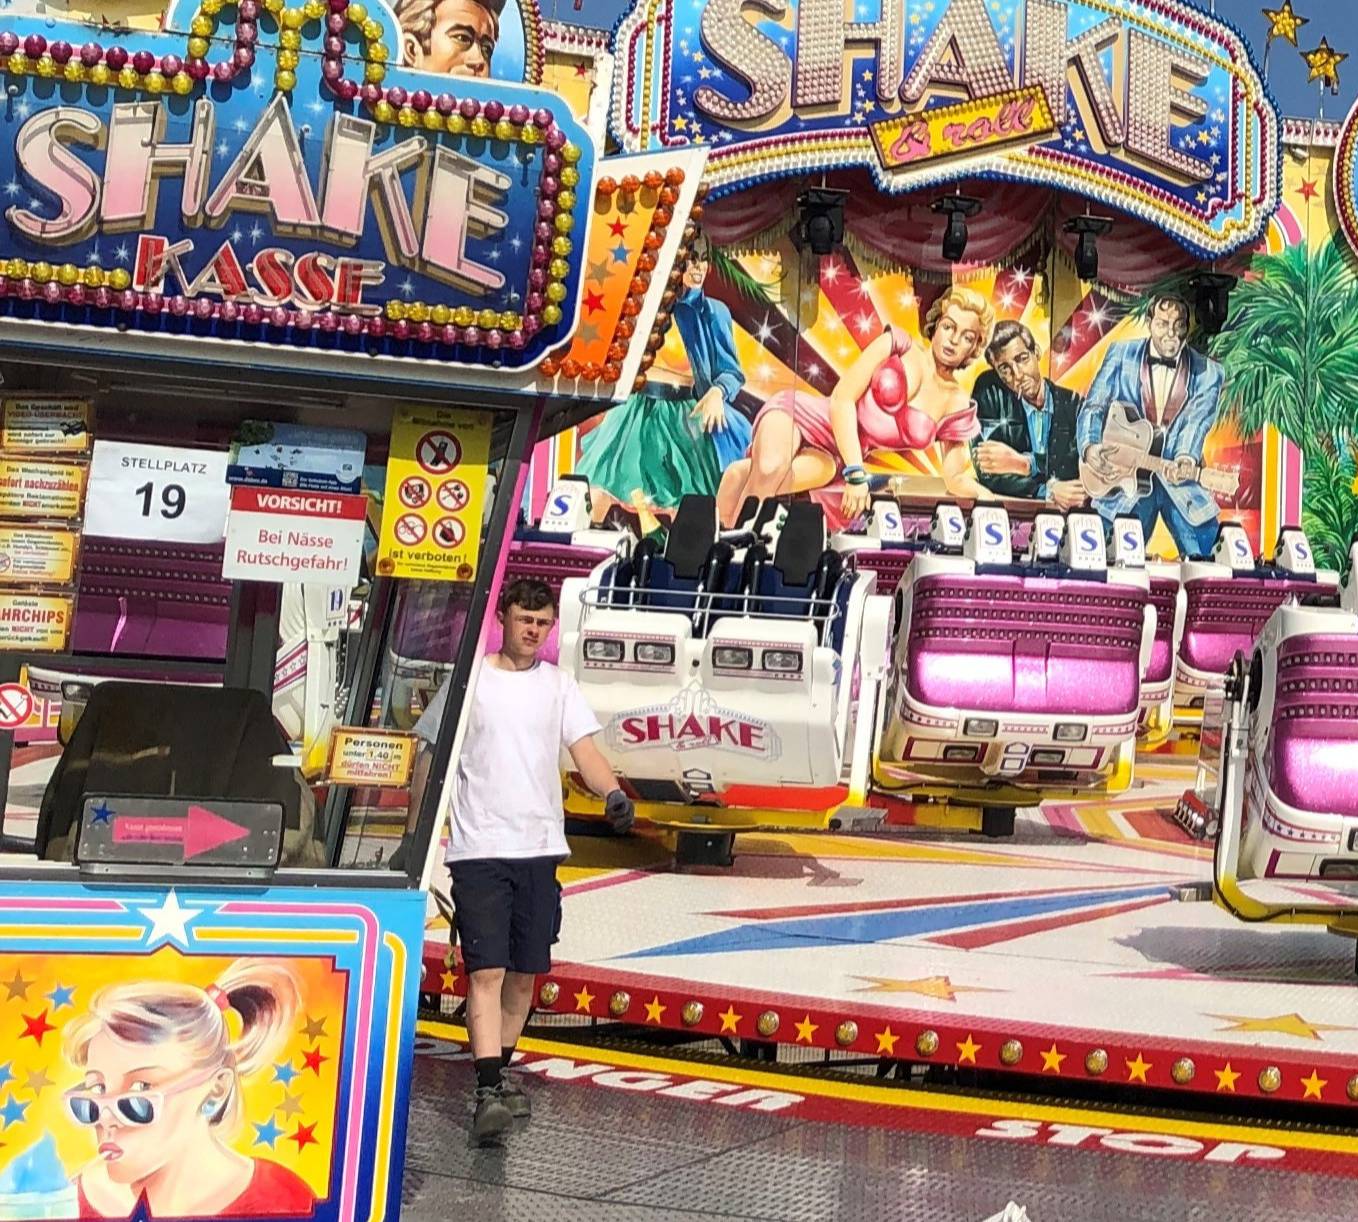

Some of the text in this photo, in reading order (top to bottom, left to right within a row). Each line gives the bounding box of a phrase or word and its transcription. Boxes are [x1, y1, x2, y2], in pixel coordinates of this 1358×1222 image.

[692, 0, 1215, 184] SHAKE
[942, 97, 1036, 147] roll
[5, 91, 514, 290] SHAKE
[133, 234, 386, 316] KASSE
[121, 456, 208, 474] STELLPLATZ
[135, 481, 186, 519] 19
[257, 493, 343, 514] VORSICHT!
[550, 495, 570, 518] S
[258, 528, 334, 548] Bei Nässe
[985, 523, 1003, 546] S
[1045, 527, 1061, 547] S
[1081, 529, 1098, 551] S
[1123, 531, 1138, 551] S
[1234, 539, 1248, 557] S
[1295, 542, 1308, 560] S
[236, 549, 348, 571] Rutschgefahr!
[622, 712, 765, 752] SHAKE
[342, 749, 365, 758] unter
[344, 737, 403, 750] Personen
[341, 759, 401, 771] dürfen NICHT
[346, 768, 392, 779] mitfahren!
[975, 1119, 1287, 1162] STOP
